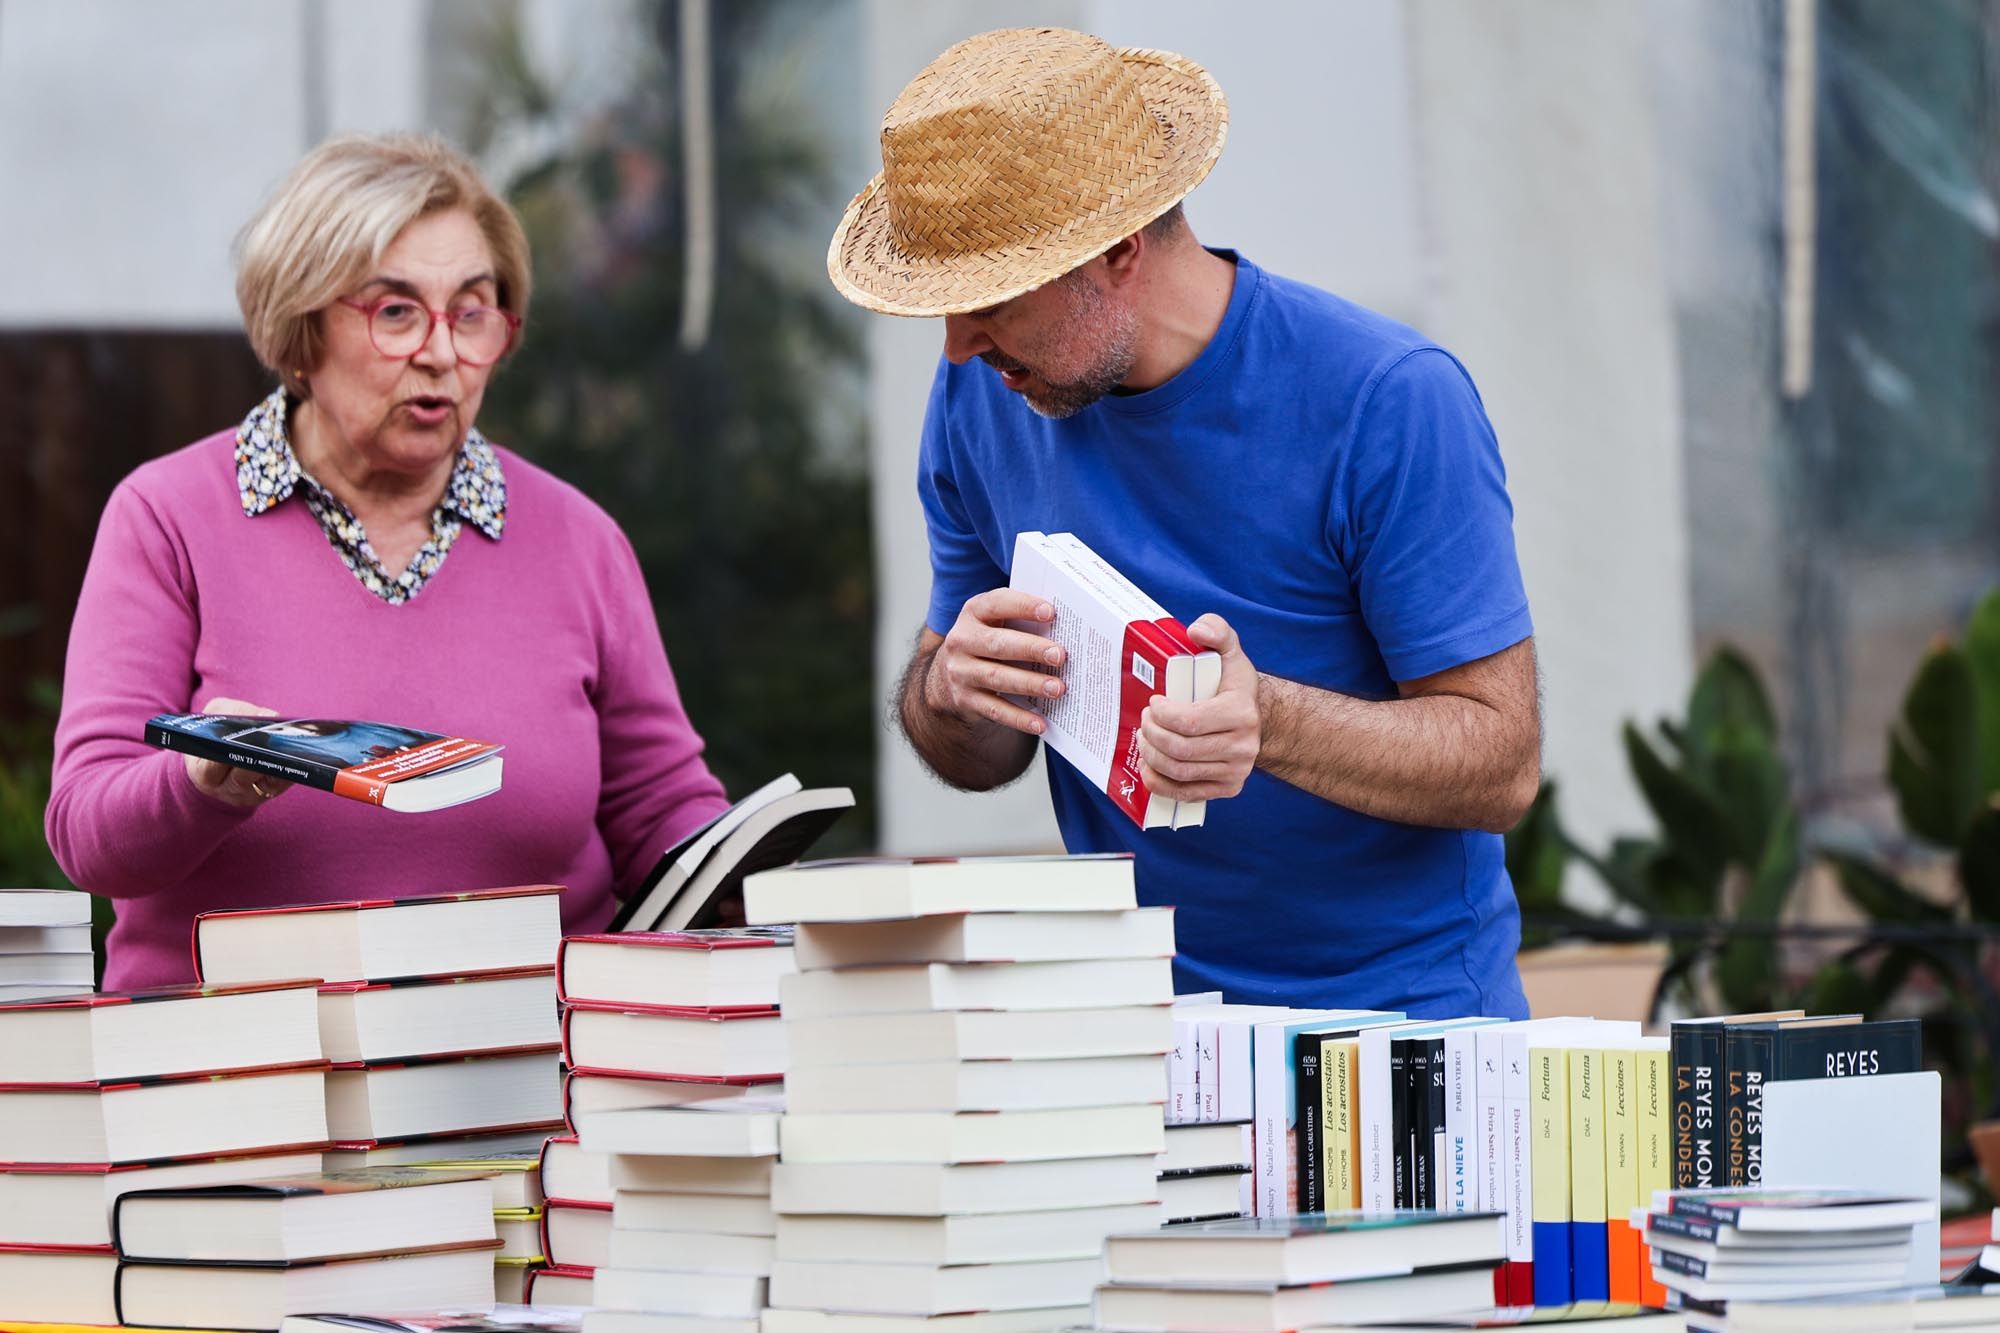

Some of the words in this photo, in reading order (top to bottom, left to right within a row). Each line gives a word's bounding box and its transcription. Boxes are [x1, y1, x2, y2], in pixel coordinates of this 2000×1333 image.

[246, 756, 254, 765] EL
[258, 759, 284, 771] Aramburu
[285, 766, 309, 778] Fernando
[1302, 1055, 1317, 1064] 650
[1306, 1067, 1314, 1076] 15
[1826, 1050, 1879, 1077] REYES
[1338, 1051, 1346, 1110] aerostatos
[1541, 1056, 1550, 1101] Fortuna
[1582, 1055, 1590, 1100] Fortuna
[1616, 1059, 1625, 1117] Lecciones
[1649, 1059, 1657, 1117] Lecciones
[1677, 1066, 1691, 1091] LA
[1729, 1071, 1742, 1097] LA
[1695, 1066, 1712, 1130] REYES
[1746, 1071, 1762, 1135] REYES
[1266, 1118, 1274, 1145] Jenner
[1325, 1110, 1333, 1131] Los
[1338, 1113, 1347, 1134] Los
[1513, 1109, 1521, 1134] Elvira
[1371, 1124, 1380, 1151] Jenner
[1488, 1134, 1496, 1160] Sastre
[1266, 1145, 1274, 1176] Natalie
[1371, 1153, 1380, 1183] Natalie
[1455, 1136, 1463, 1175] NIEVE
[1308, 1168, 1315, 1180] DE
[1514, 1163, 1522, 1178] Las
[1456, 1179, 1464, 1195] LA
[1515, 1179, 1523, 1246] vulnerabilidades
